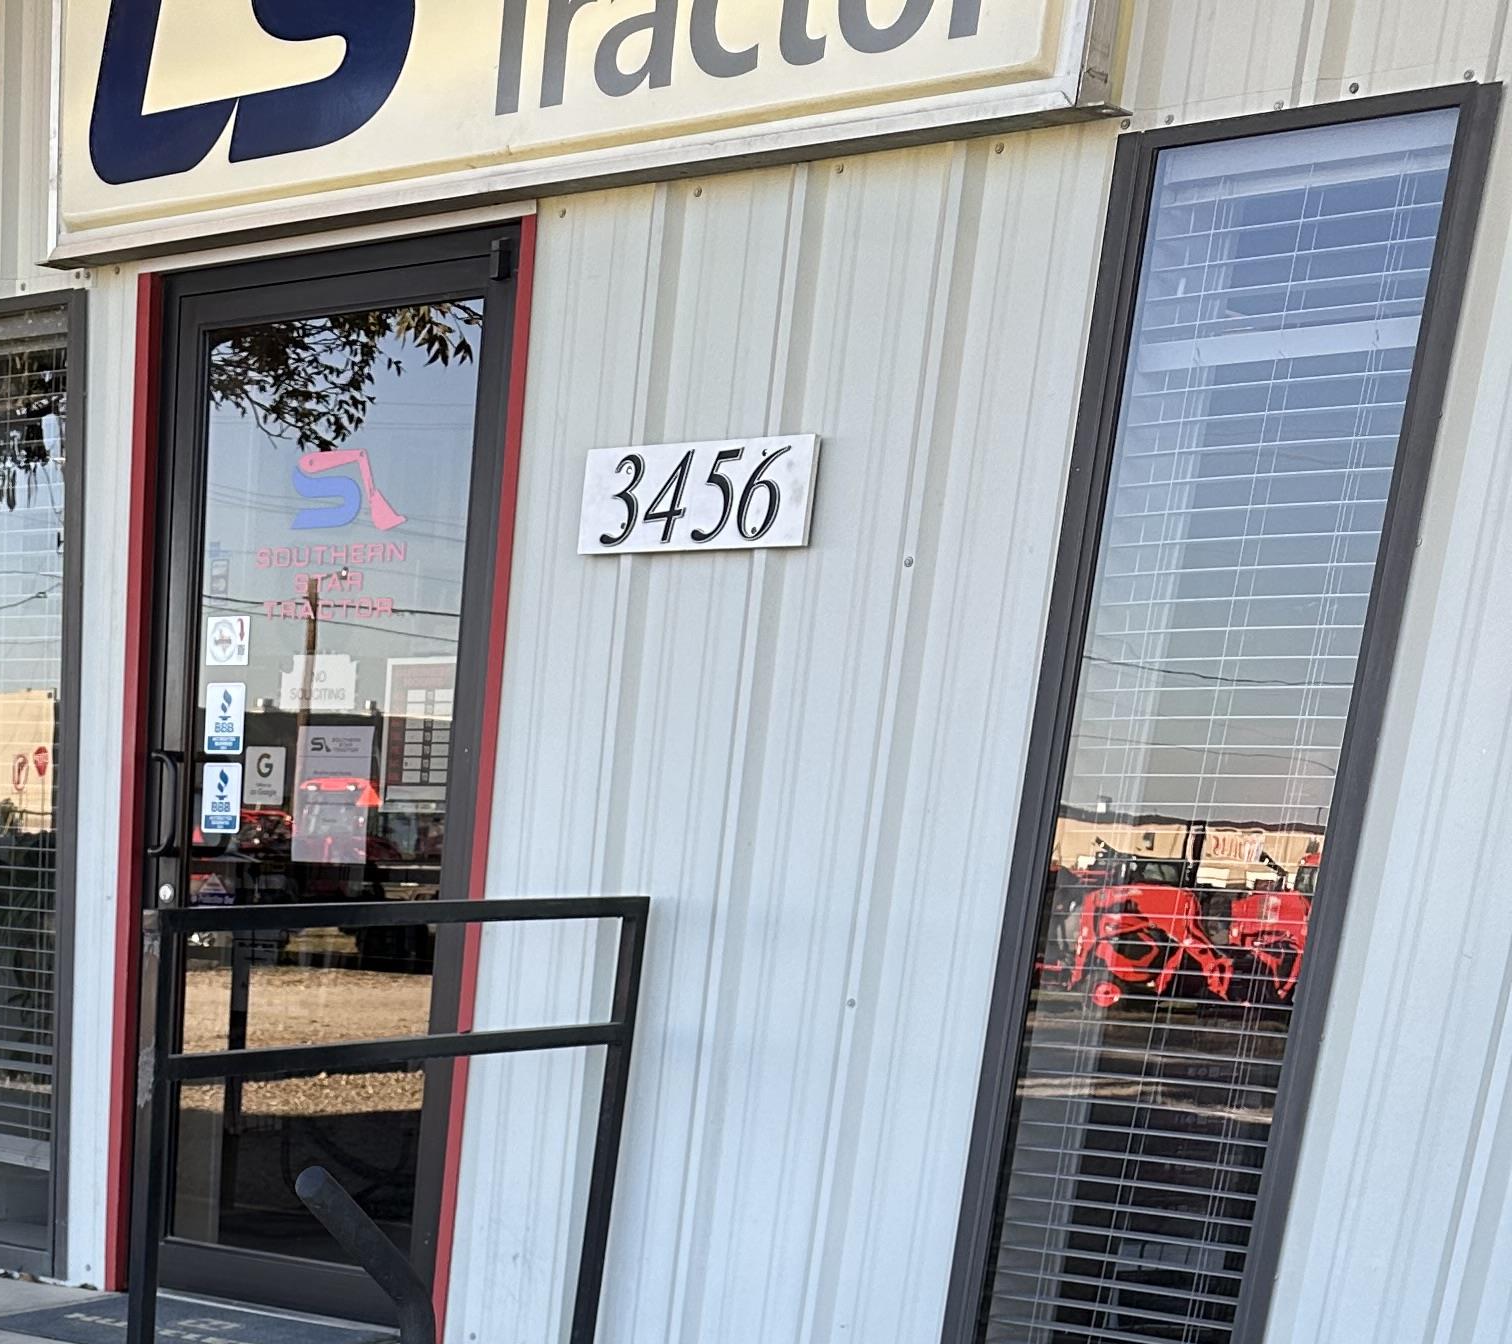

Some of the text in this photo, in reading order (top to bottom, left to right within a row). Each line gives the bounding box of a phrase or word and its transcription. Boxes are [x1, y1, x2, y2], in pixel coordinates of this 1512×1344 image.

[599, 445, 792, 546] 3456
[255, 542, 407, 569] SOUTHERN
[294, 571, 364, 593] STAR
[263, 597, 394, 622] TRACTOR
[257, 753, 274, 778] G
